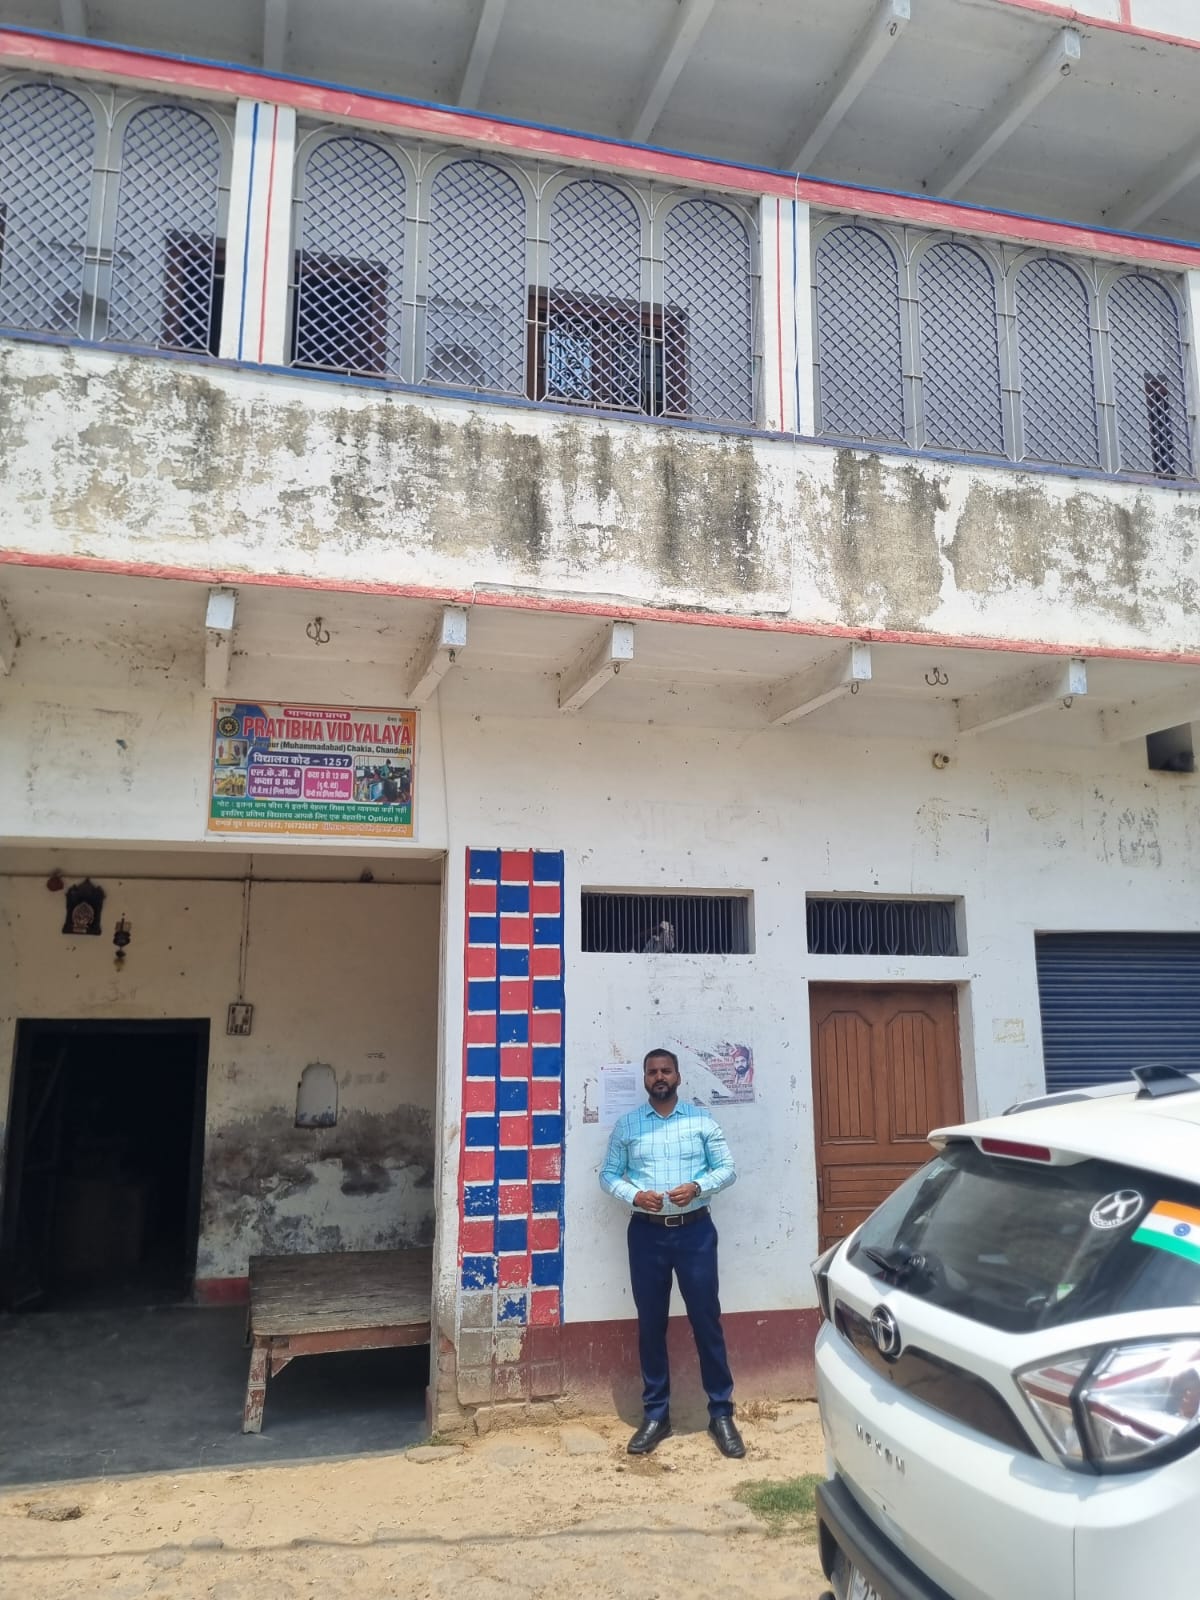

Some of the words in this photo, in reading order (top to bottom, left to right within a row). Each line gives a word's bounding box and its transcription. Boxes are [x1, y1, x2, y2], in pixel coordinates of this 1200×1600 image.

[243, 717, 324, 742] PRATIBHA
[326, 720, 412, 746] VIDYALAYA
[280, 741, 346, 752] (Muhammadabad)
[347, 744, 375, 753] Chakia,
[253, 752, 289, 763] विद्यालय
[290, 754, 310, 765] कोड
[324, 758, 349, 766] 1257
[368, 813, 393, 823] Option
